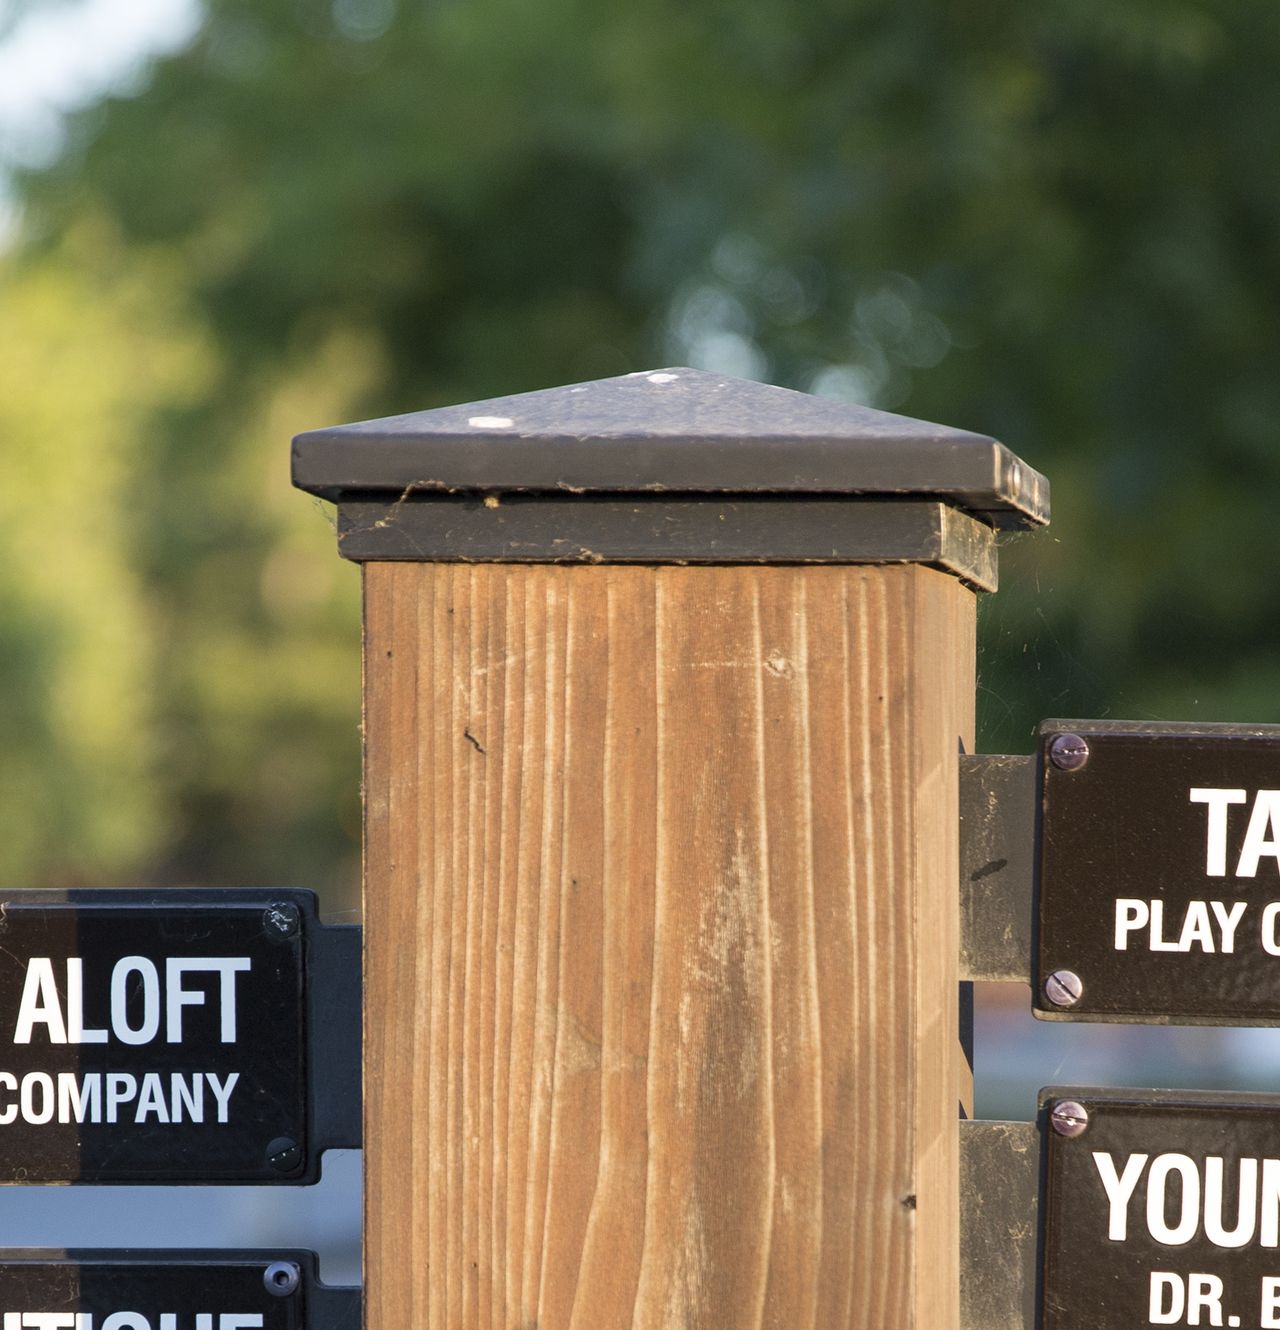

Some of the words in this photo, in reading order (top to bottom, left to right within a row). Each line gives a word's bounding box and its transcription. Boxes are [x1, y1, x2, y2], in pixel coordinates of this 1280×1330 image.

[1114, 898, 1248, 954] PLAY
[13, 955, 251, 1045] ALOFT
[1148, 1271, 1241, 1328] DR.
